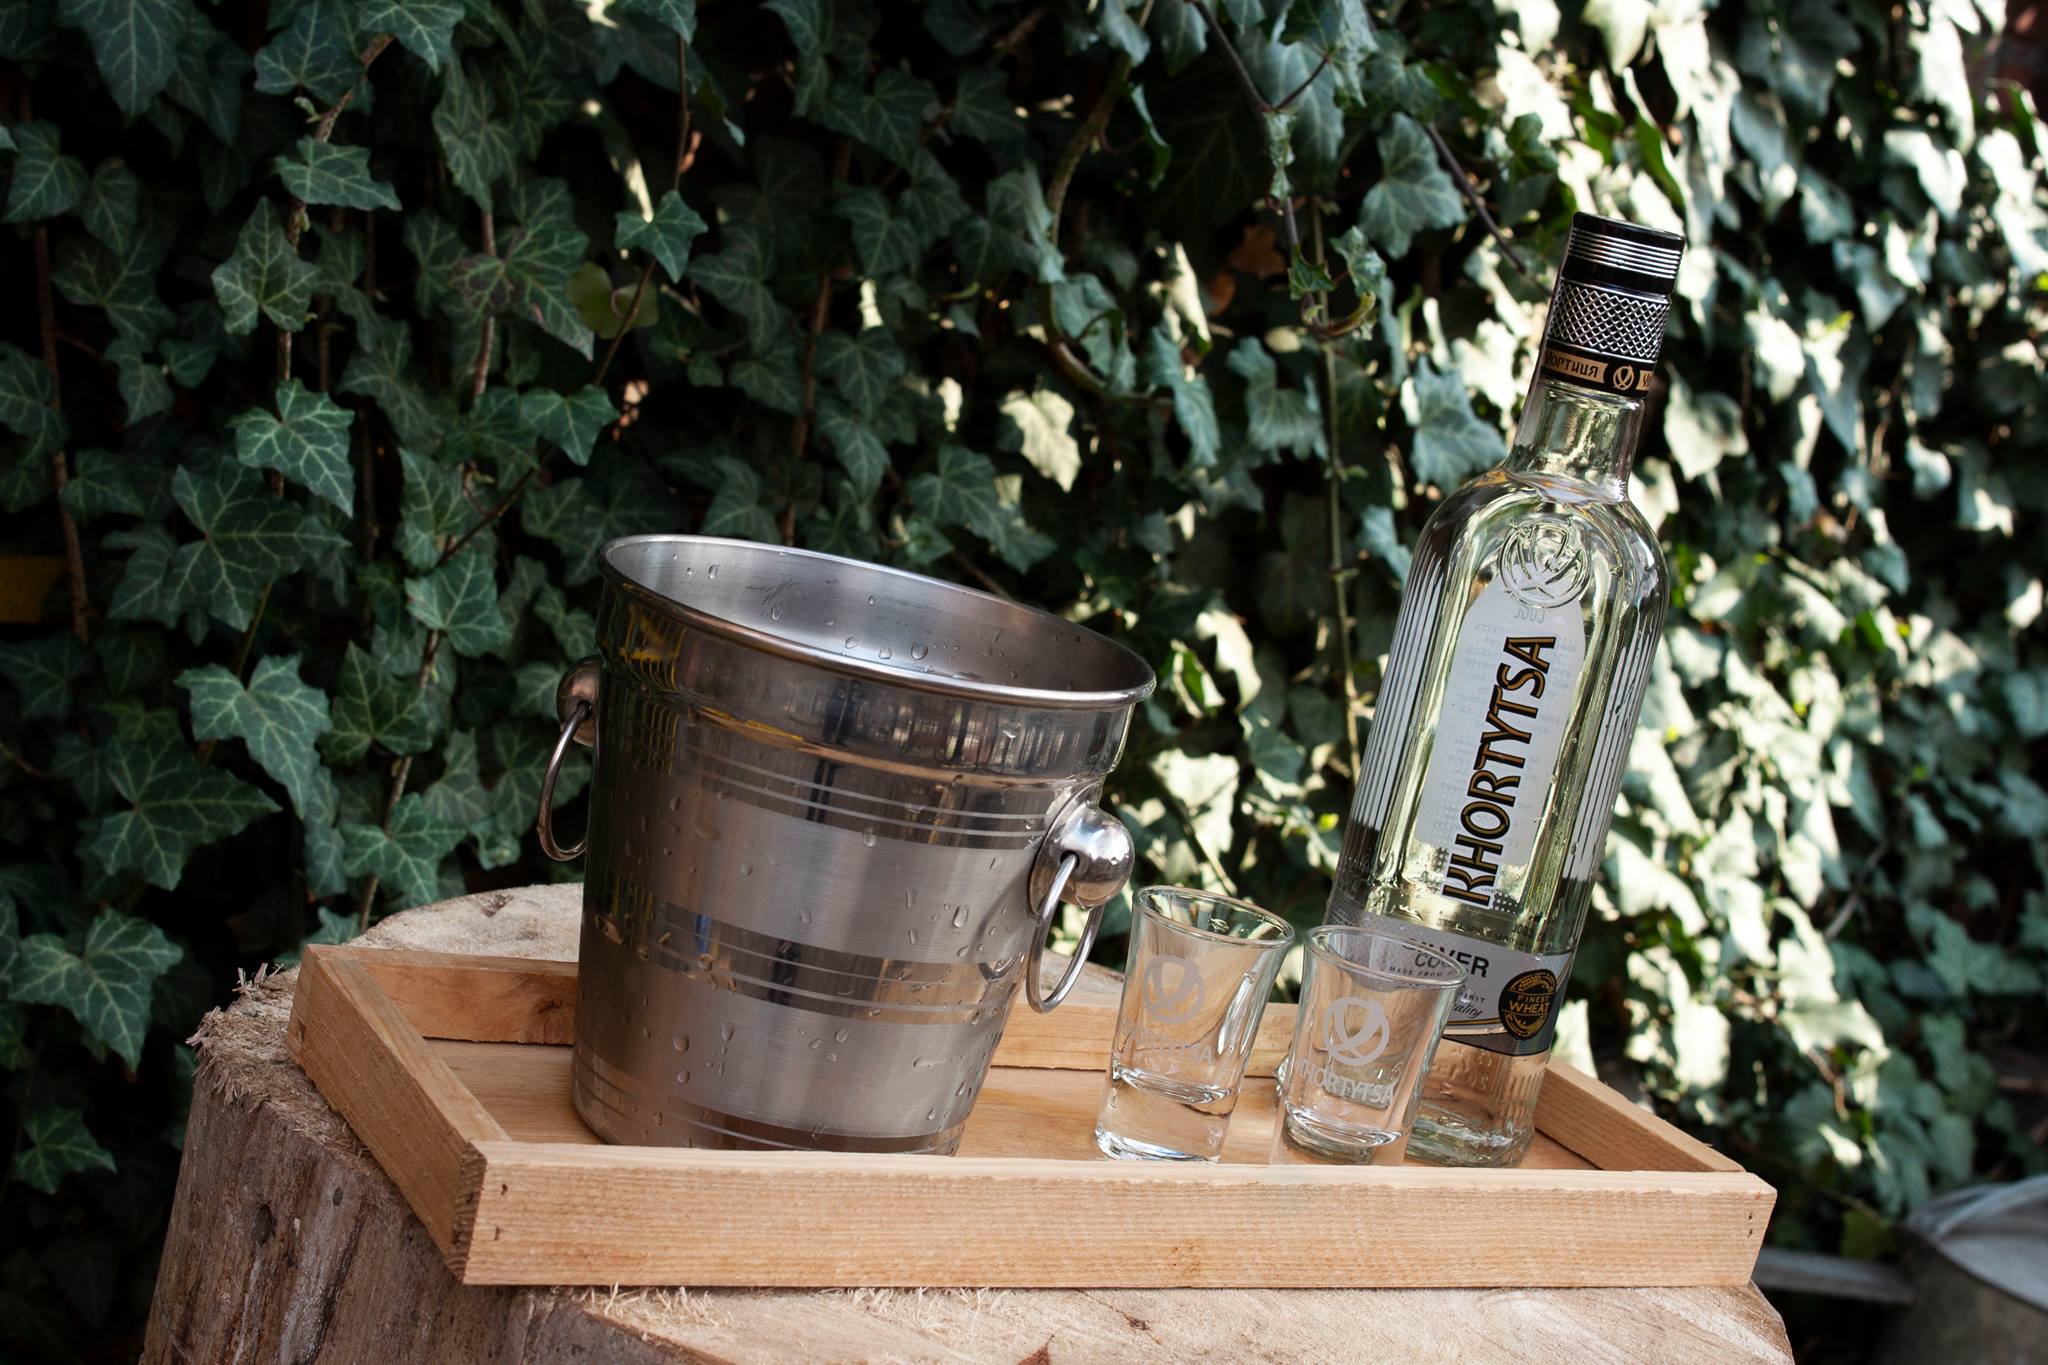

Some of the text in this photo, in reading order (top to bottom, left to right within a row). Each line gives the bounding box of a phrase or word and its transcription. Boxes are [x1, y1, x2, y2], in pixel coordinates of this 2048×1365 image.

[1442, 636, 1557, 907] KHORTYTSA
[1453, 1003, 1484, 1019] ality
[1509, 1000, 1551, 1014] WHEAT
